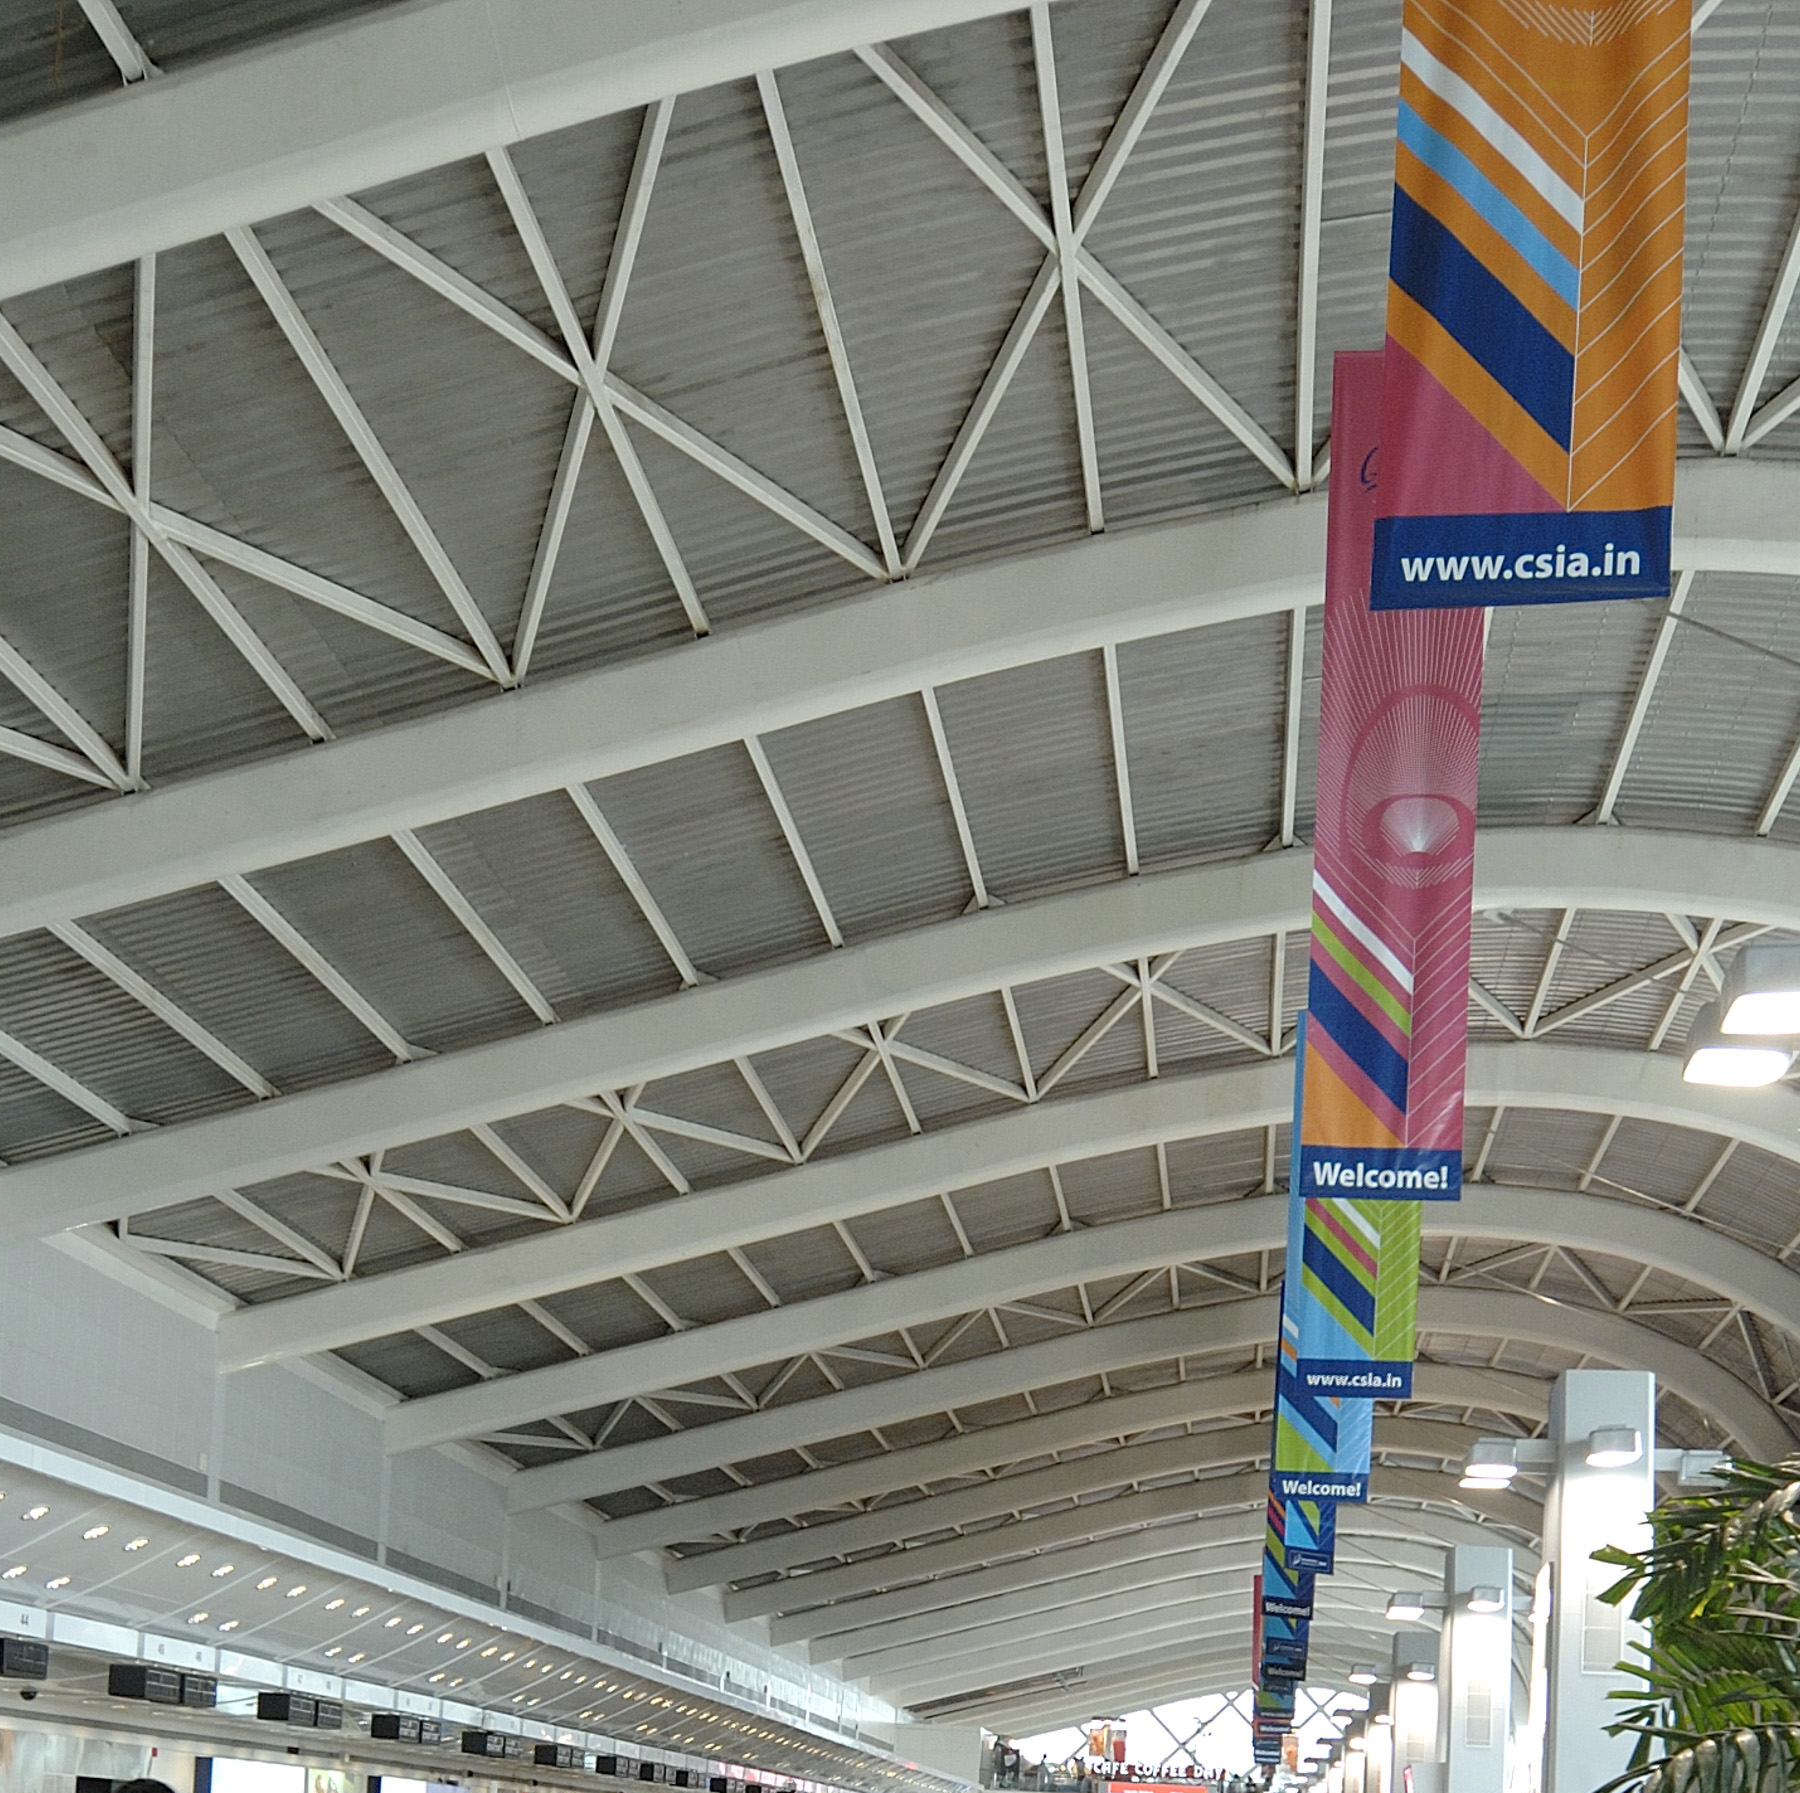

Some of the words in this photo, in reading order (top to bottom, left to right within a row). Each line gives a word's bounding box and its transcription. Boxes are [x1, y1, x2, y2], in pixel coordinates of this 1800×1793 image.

[1400, 543, 1641, 582] www.csia.in
[1312, 1161, 1449, 1189] Welcome!
[1306, 1372, 1403, 1388] www.csia.in
[1282, 1480, 1361, 1497] Welcome!
[1135, 1763, 1187, 1777] COFFEE
